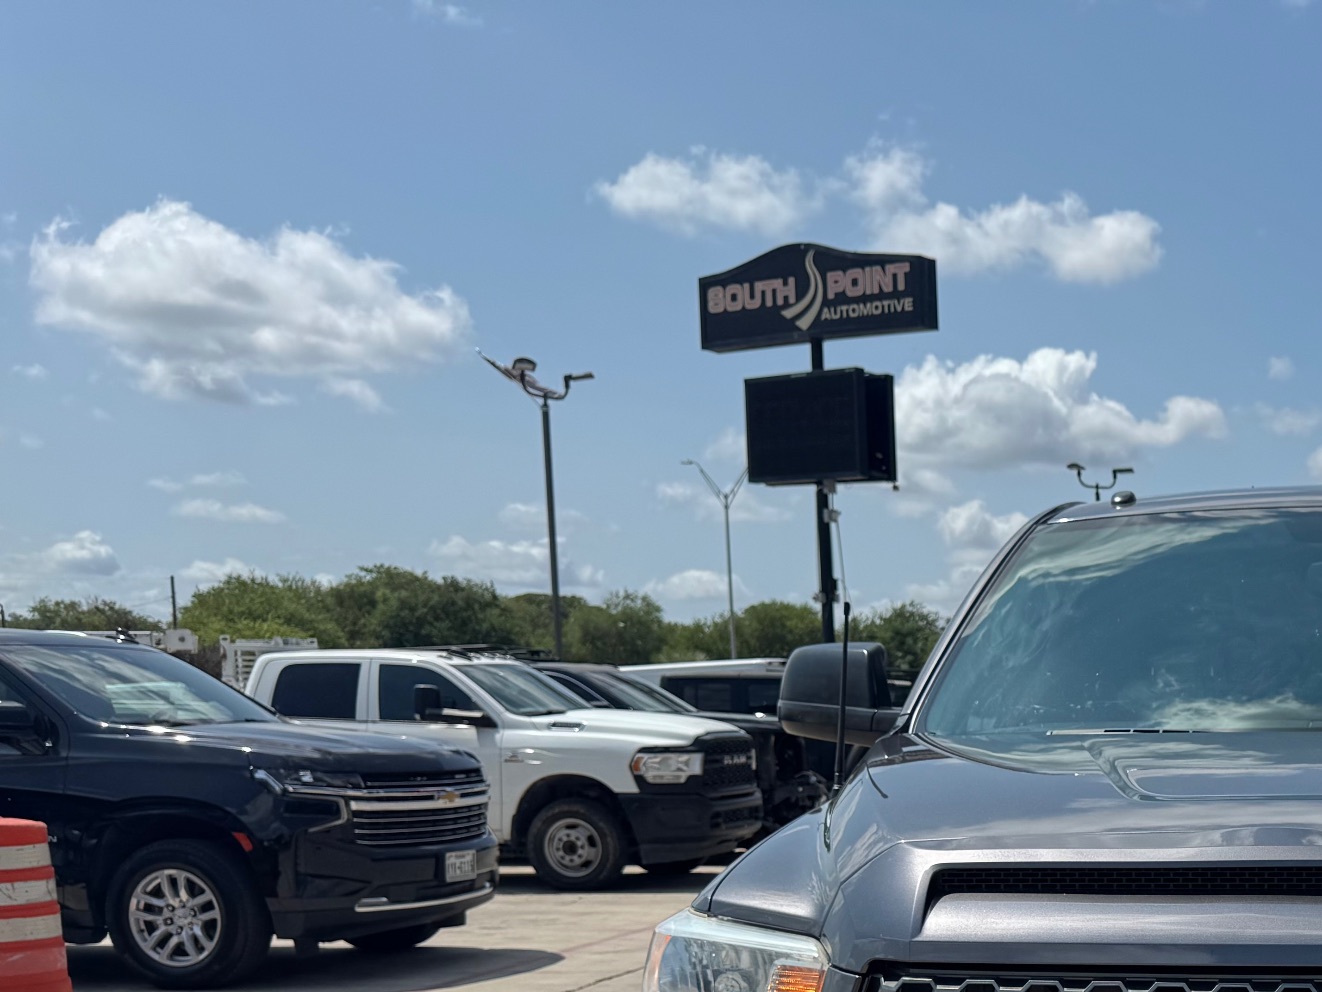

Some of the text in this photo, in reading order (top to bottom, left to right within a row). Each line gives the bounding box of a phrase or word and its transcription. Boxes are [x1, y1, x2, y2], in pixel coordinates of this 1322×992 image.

[707, 262, 911, 314] SOUTH POINT
[821, 297, 914, 321] AUTOMOTIVE
